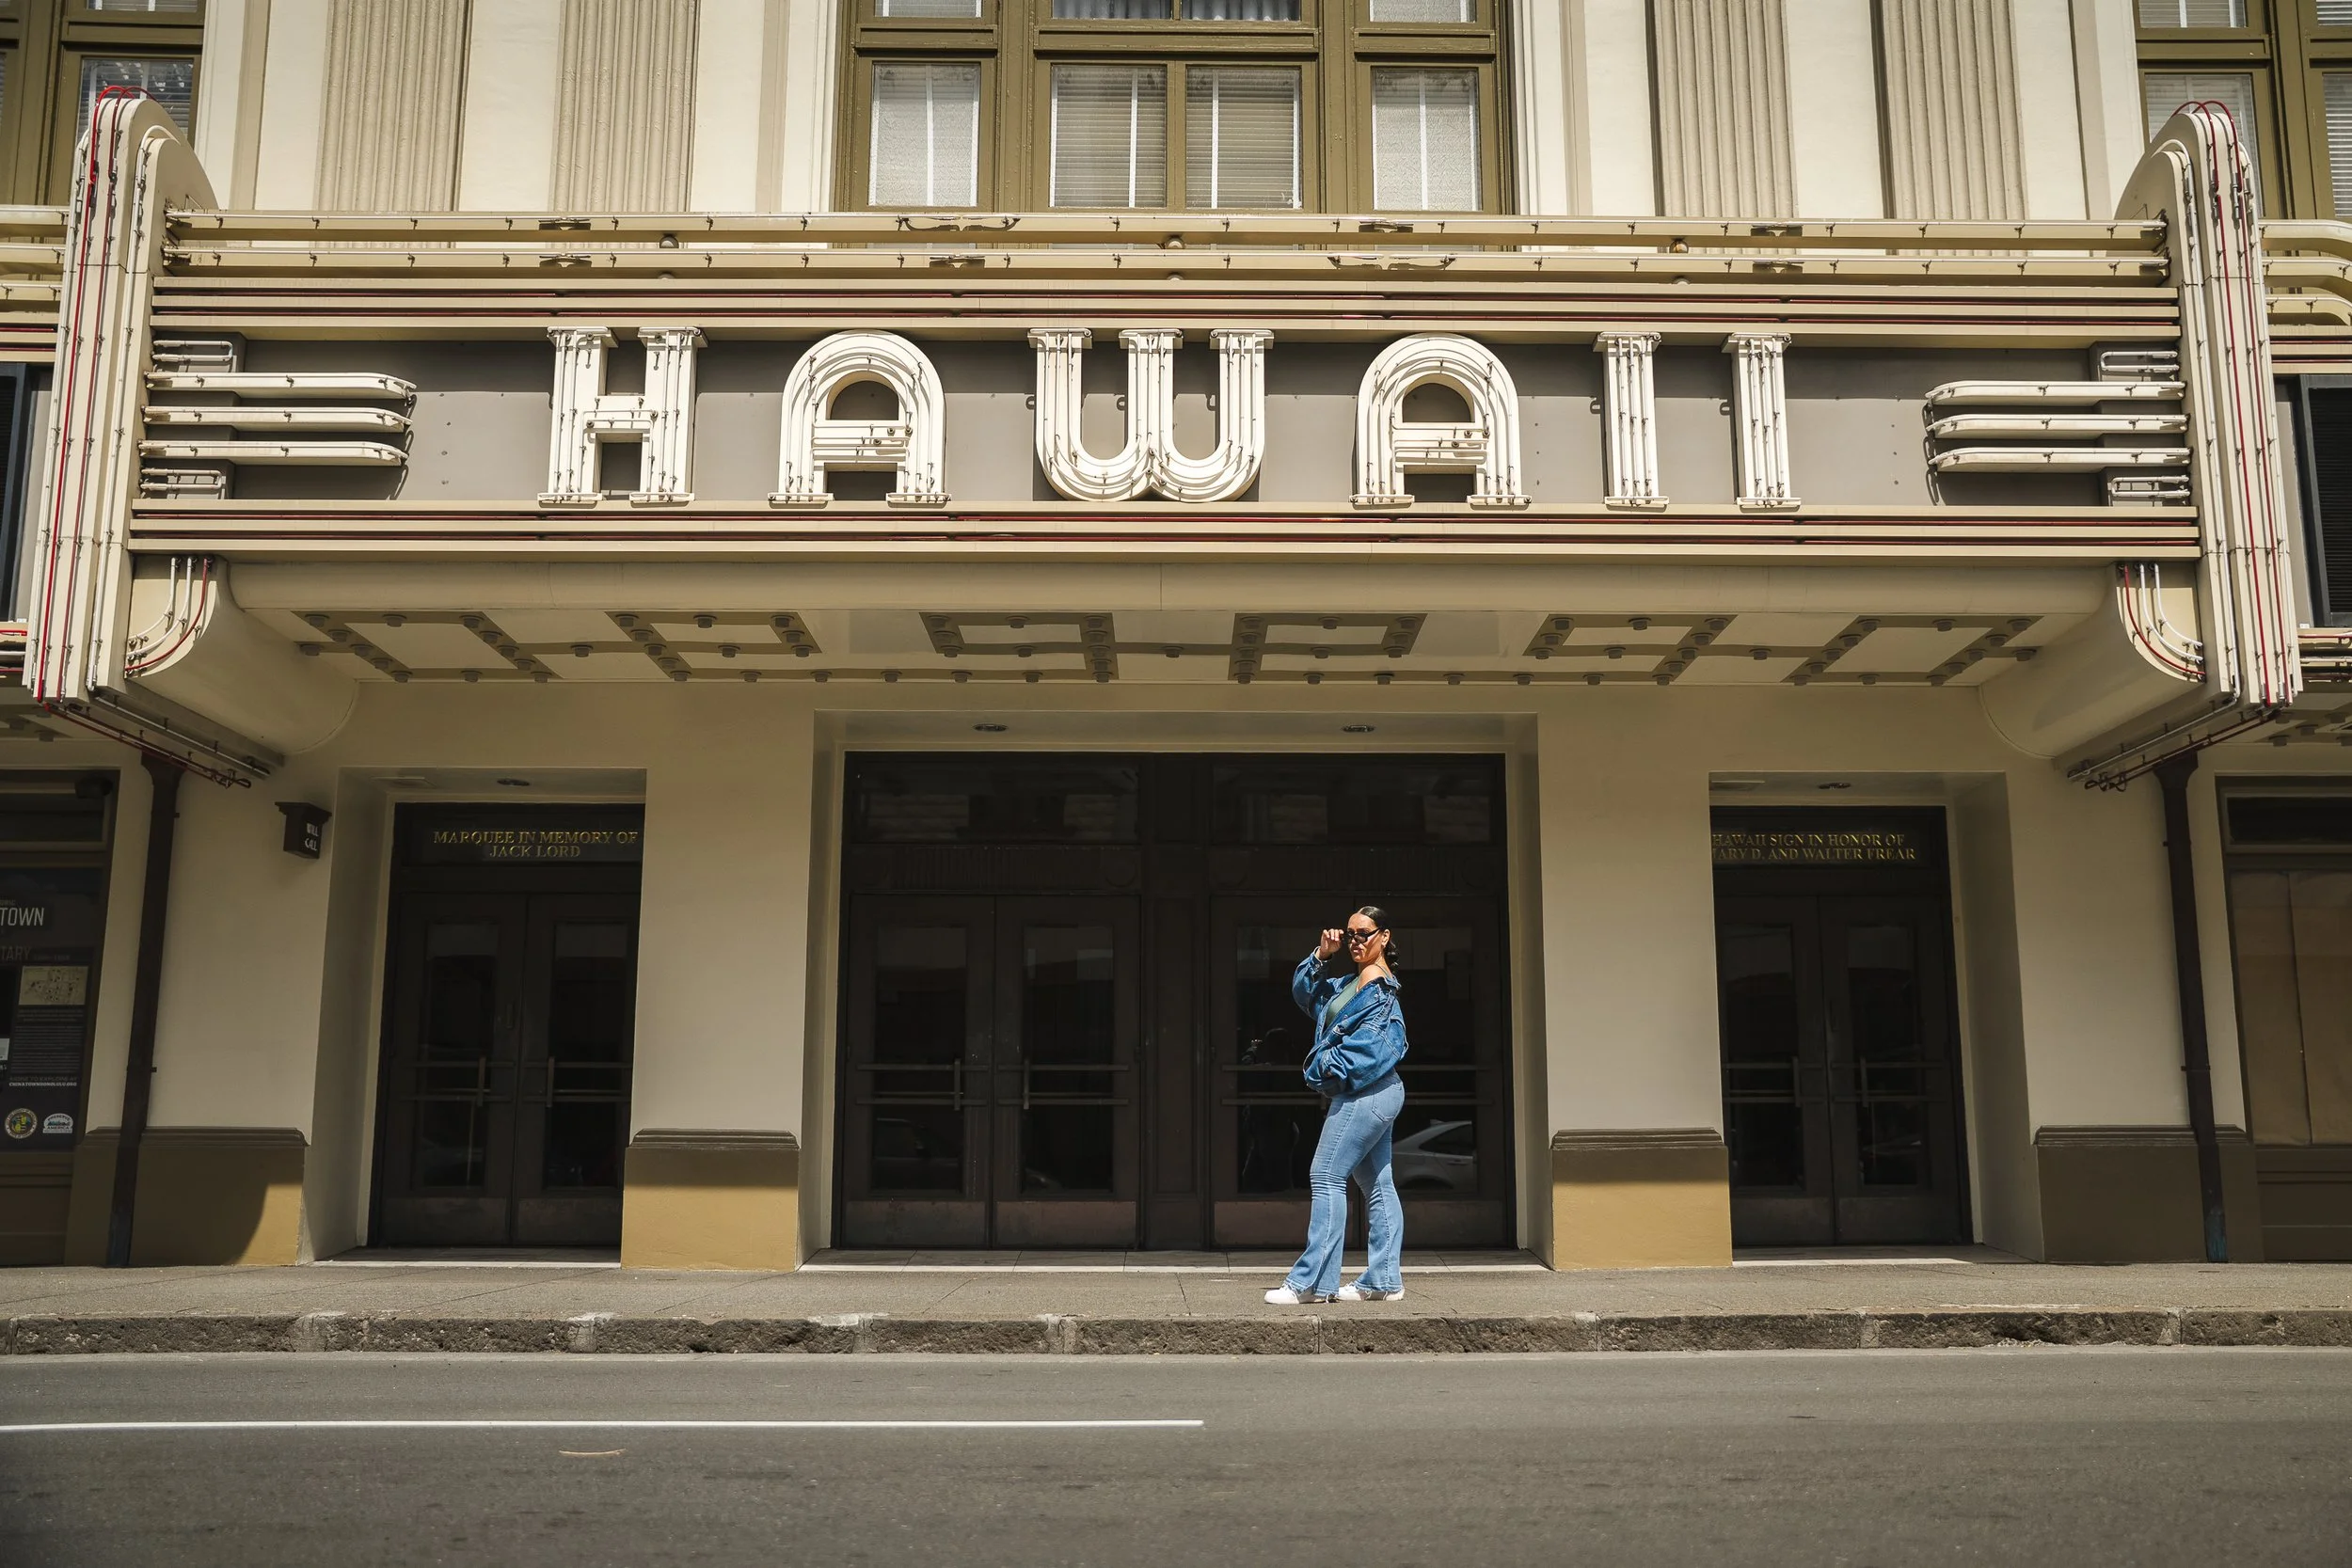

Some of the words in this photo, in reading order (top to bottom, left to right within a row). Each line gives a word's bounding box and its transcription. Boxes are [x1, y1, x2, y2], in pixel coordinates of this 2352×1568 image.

[537, 325, 1802, 510] HAWAII
[305, 838, 317, 850] CALL
[433, 832, 515, 844] MARQUEE
[518, 832, 536, 843] IN
[539, 832, 613, 843] MEMORY
[616, 832, 638, 844] OF
[1711, 834, 1767, 846] HAWAII
[1770, 834, 1804, 846] SIGN
[1808, 834, 1823, 846] IN
[1828, 834, 1882, 846] HONOR
[1885, 834, 1904, 846] OF
[489, 846, 532, 858] JACK
[535, 846, 580, 858] LORD
[1752, 848, 1765, 860] D.
[1769, 848, 1799, 860] AND
[1803, 848, 1863, 860] WALTER
[1867, 848, 1916, 860] FREAR
